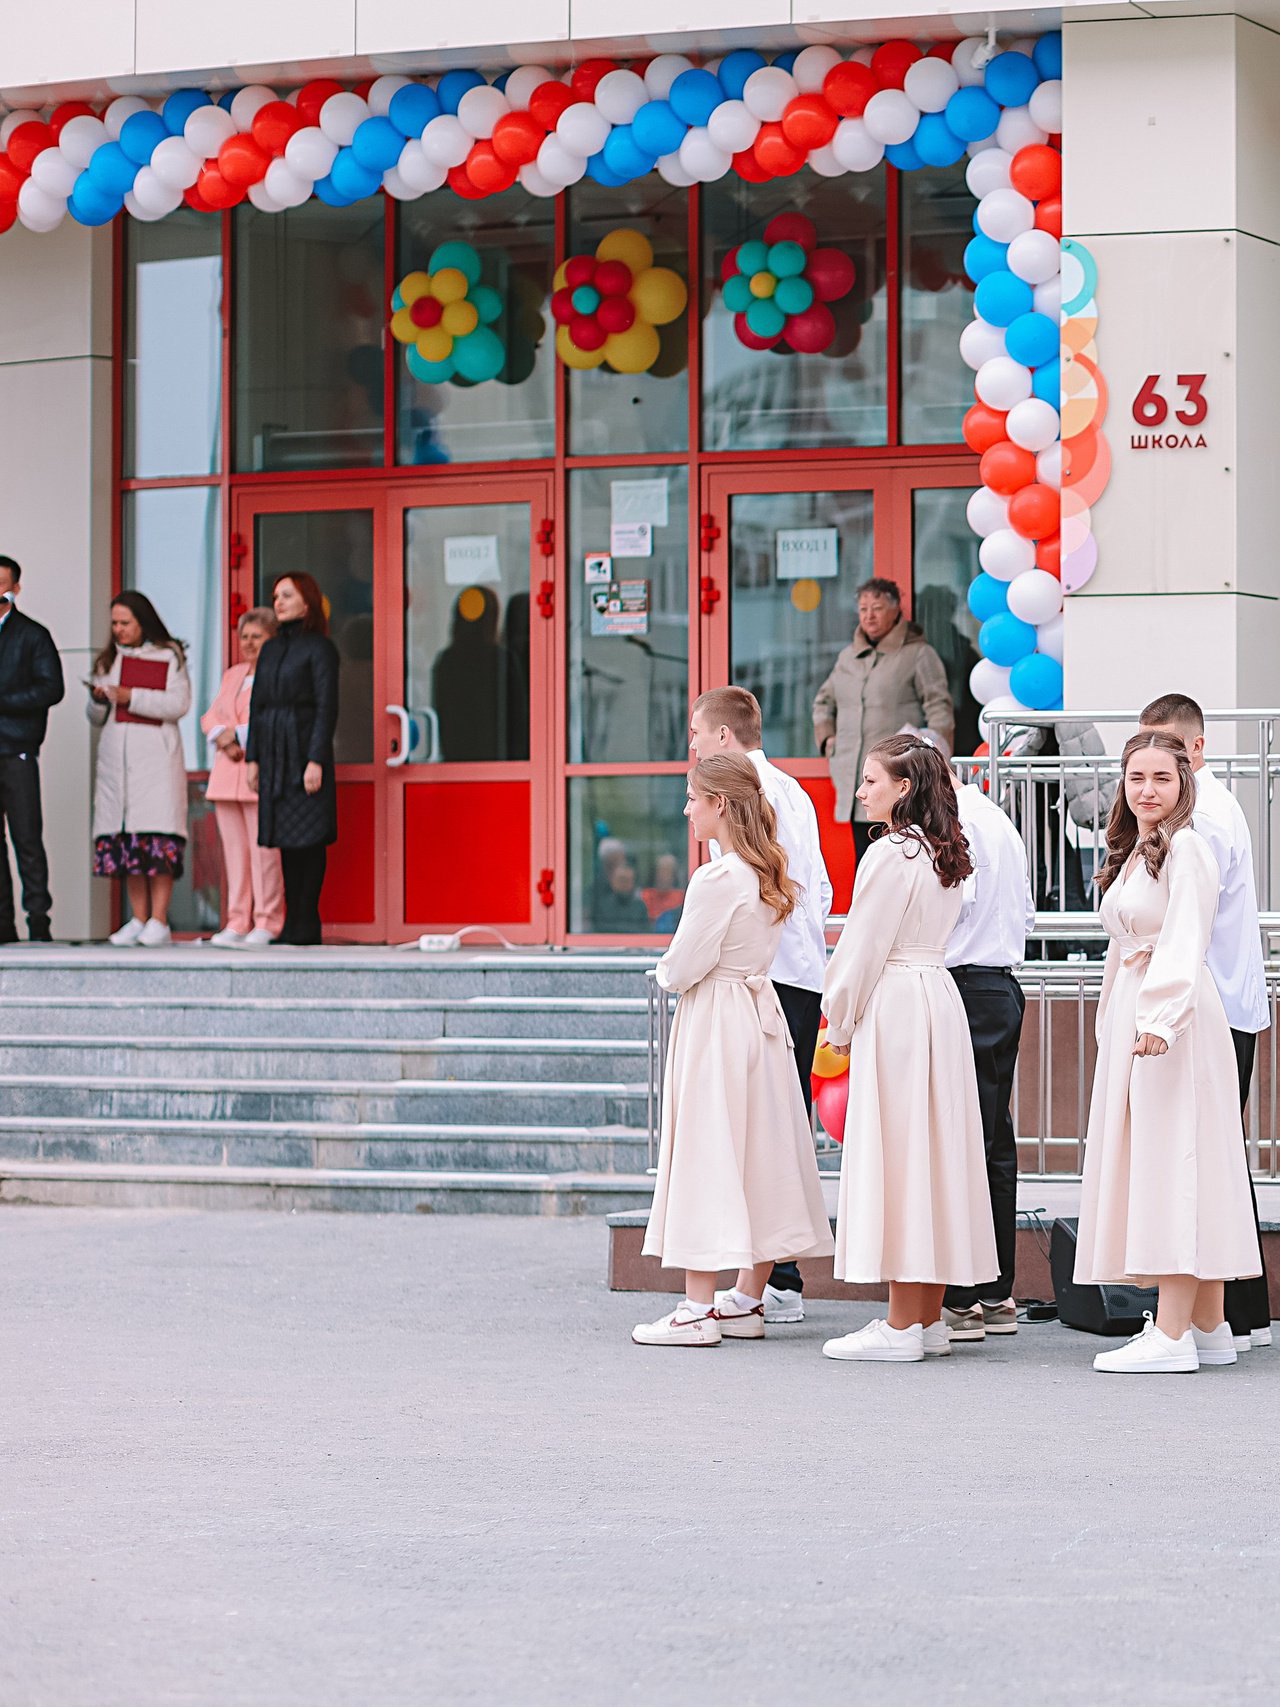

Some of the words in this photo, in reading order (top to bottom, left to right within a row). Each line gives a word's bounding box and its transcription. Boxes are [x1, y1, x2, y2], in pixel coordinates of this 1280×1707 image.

[1132, 374, 1208, 427] 63
[1131, 434, 1207, 449] ШКОЛА
[782, 539, 819, 553] ВХОД
